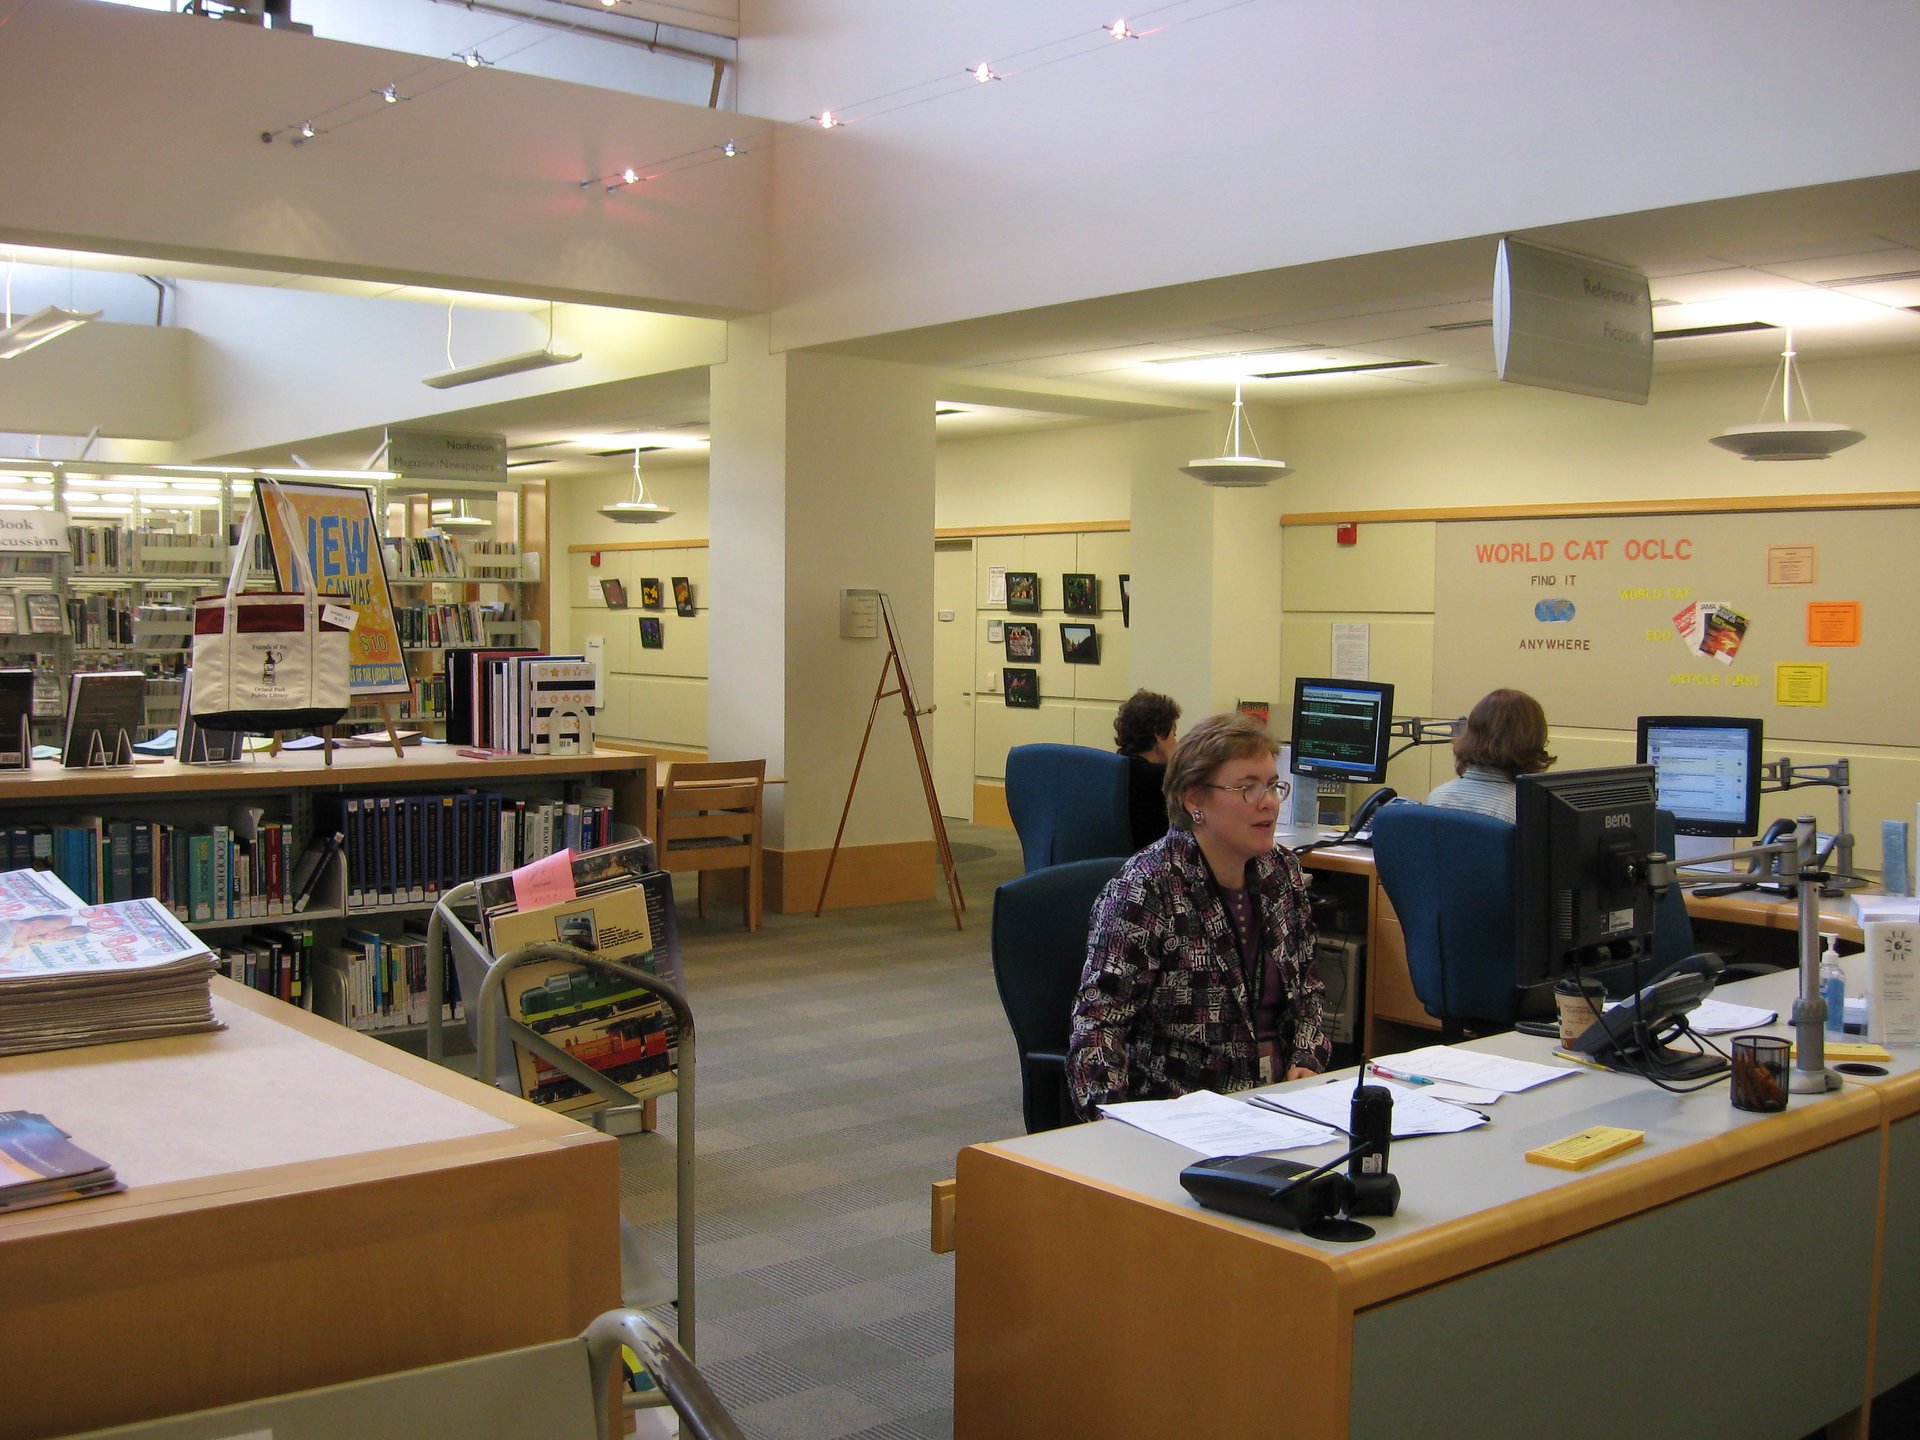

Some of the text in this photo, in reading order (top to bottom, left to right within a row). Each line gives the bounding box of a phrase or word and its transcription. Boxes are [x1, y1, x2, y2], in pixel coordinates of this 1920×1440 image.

[1584, 278, 1636, 305] Reference
[1603, 321, 1639, 345] Fiction
[446, 440, 494, 452] Nonfiction
[1475, 539, 1693, 564] WORLD CAT OCLC
[1531, 574, 1577, 586] FIND IT
[1619, 587, 1692, 600] WORLD CAT
[359, 633, 388, 653] $10
[1645, 630, 1673, 641] ECO
[1518, 639, 1591, 651] ANYWHERE
[1668, 674, 1761, 688] ARTICLE FIRST
[217, 840, 226, 873] GOOD
[79, 906, 124, 930] 50
